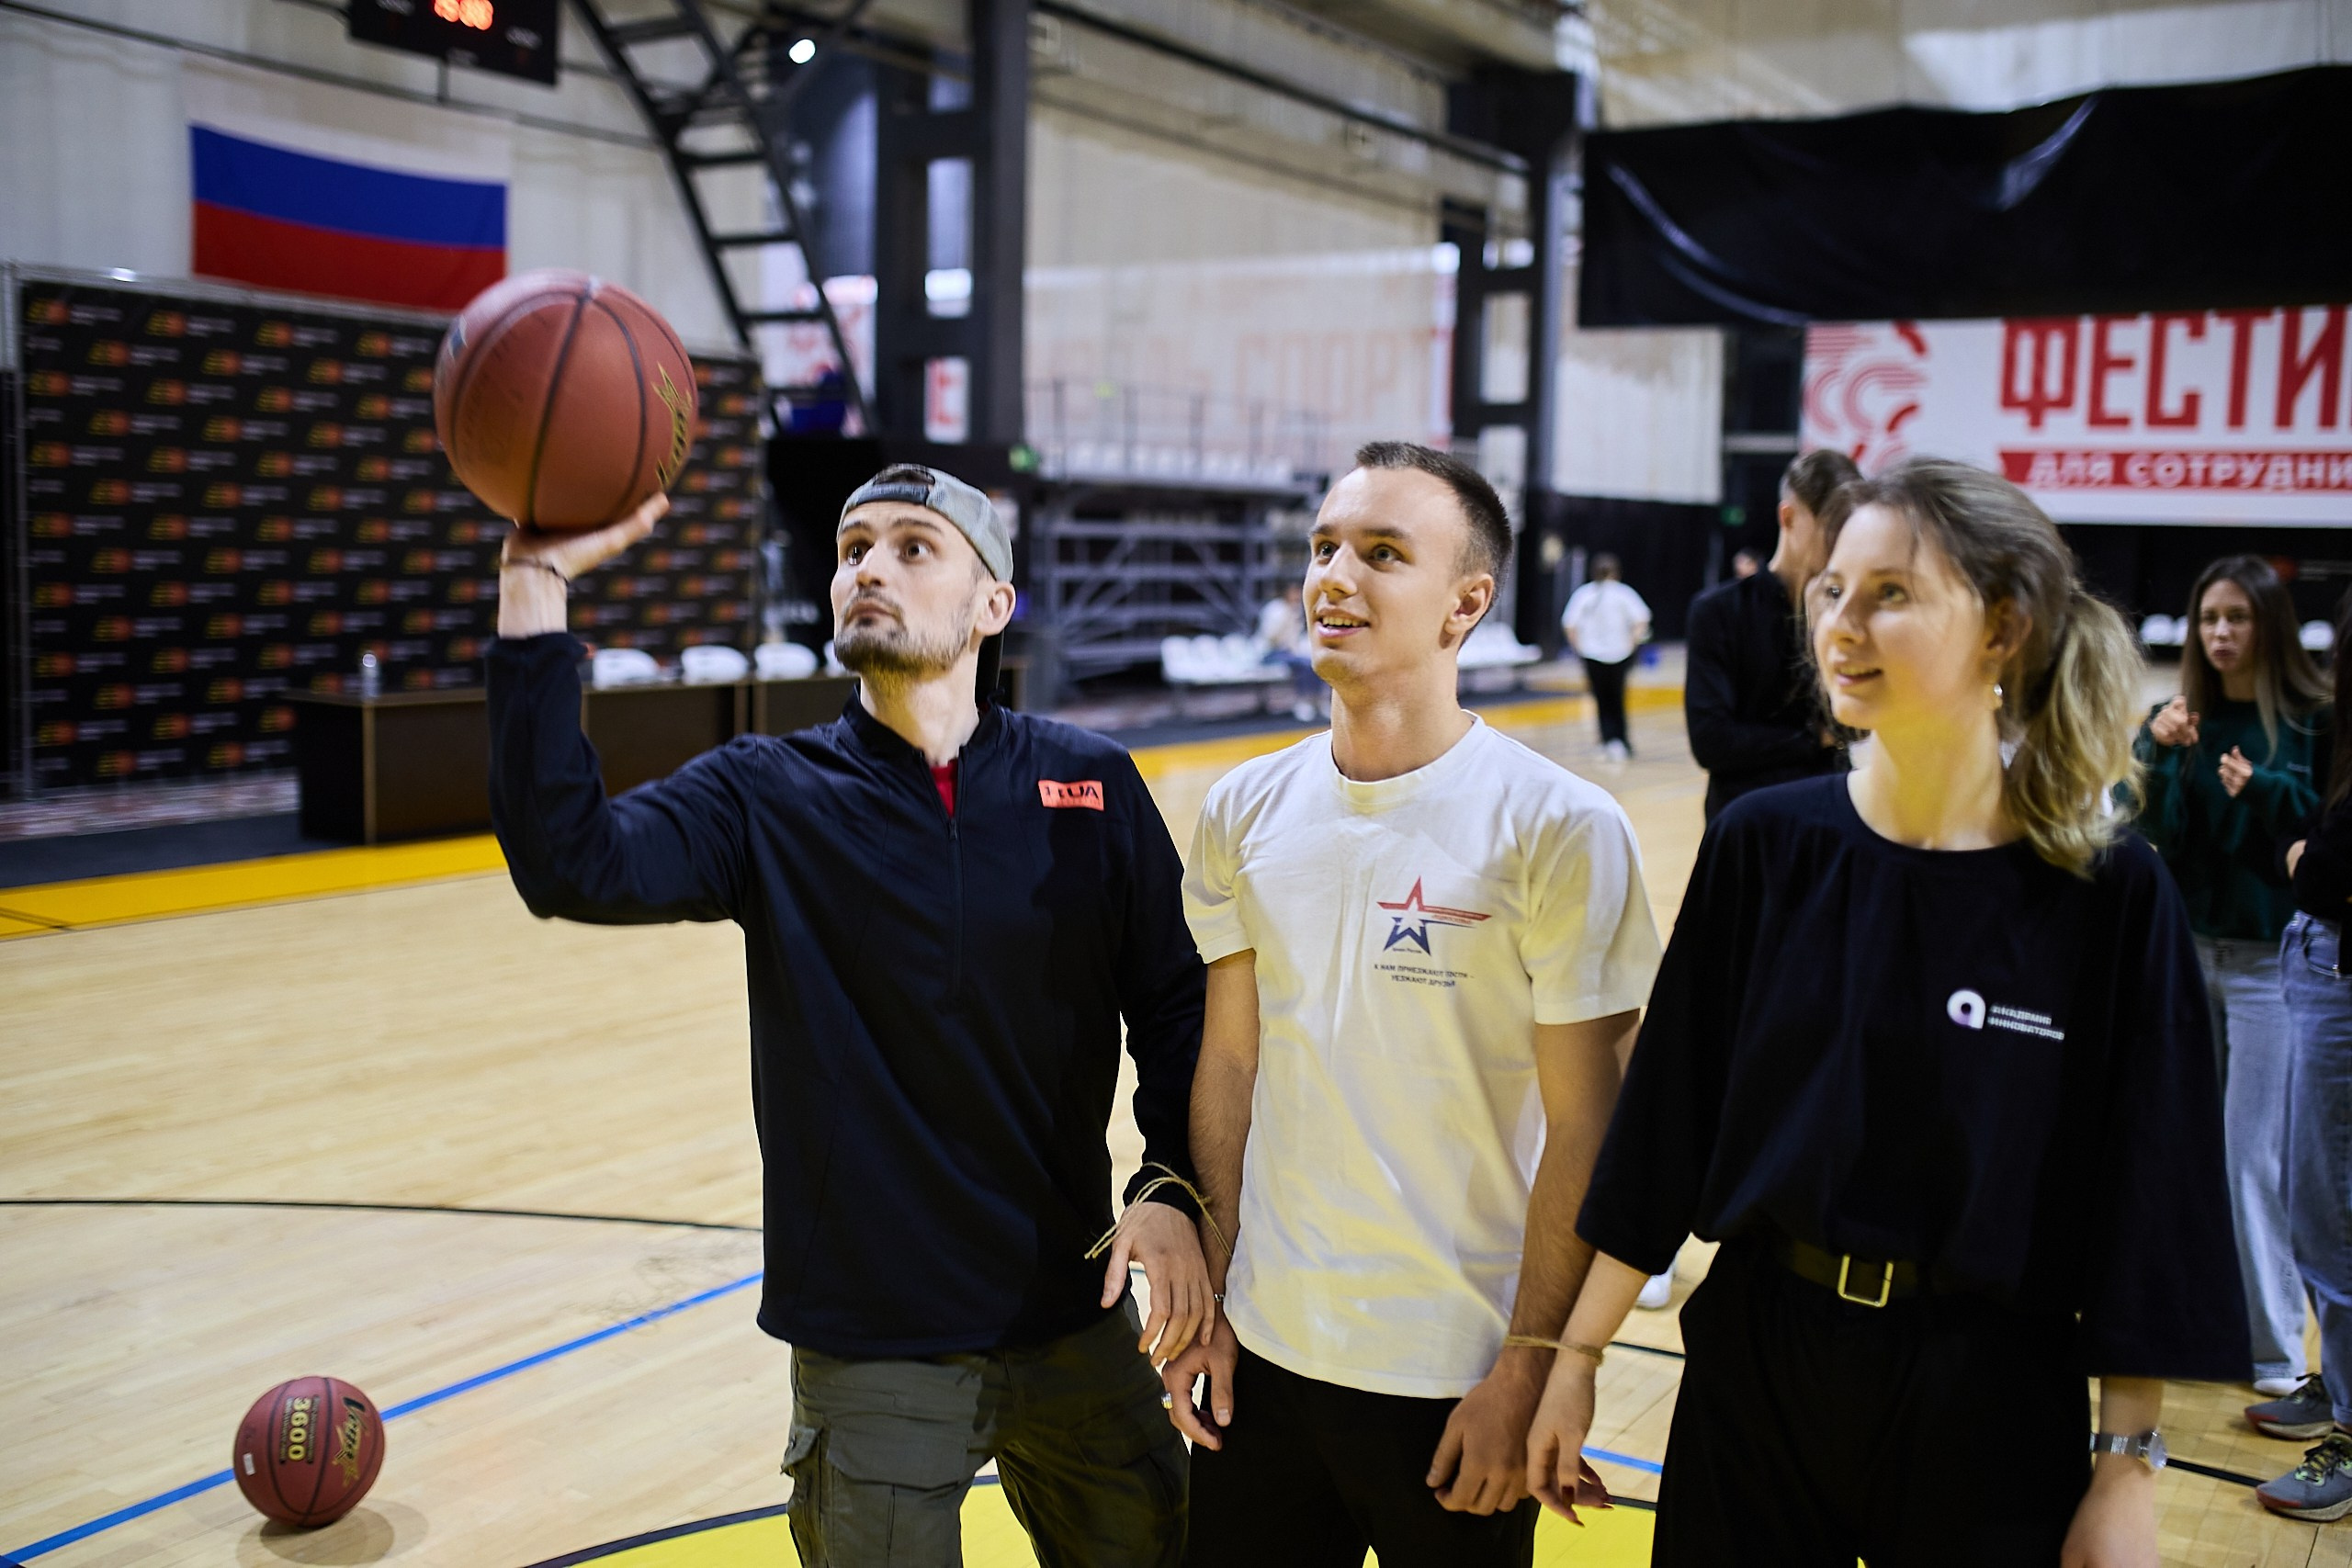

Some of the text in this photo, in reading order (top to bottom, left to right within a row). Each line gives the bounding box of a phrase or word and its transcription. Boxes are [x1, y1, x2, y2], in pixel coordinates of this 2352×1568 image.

[2000, 309, 2352, 429] ФЕСТИ
[2025, 454, 2114, 489] ДЛЯ
[288, 1396, 312, 1462] 3600
